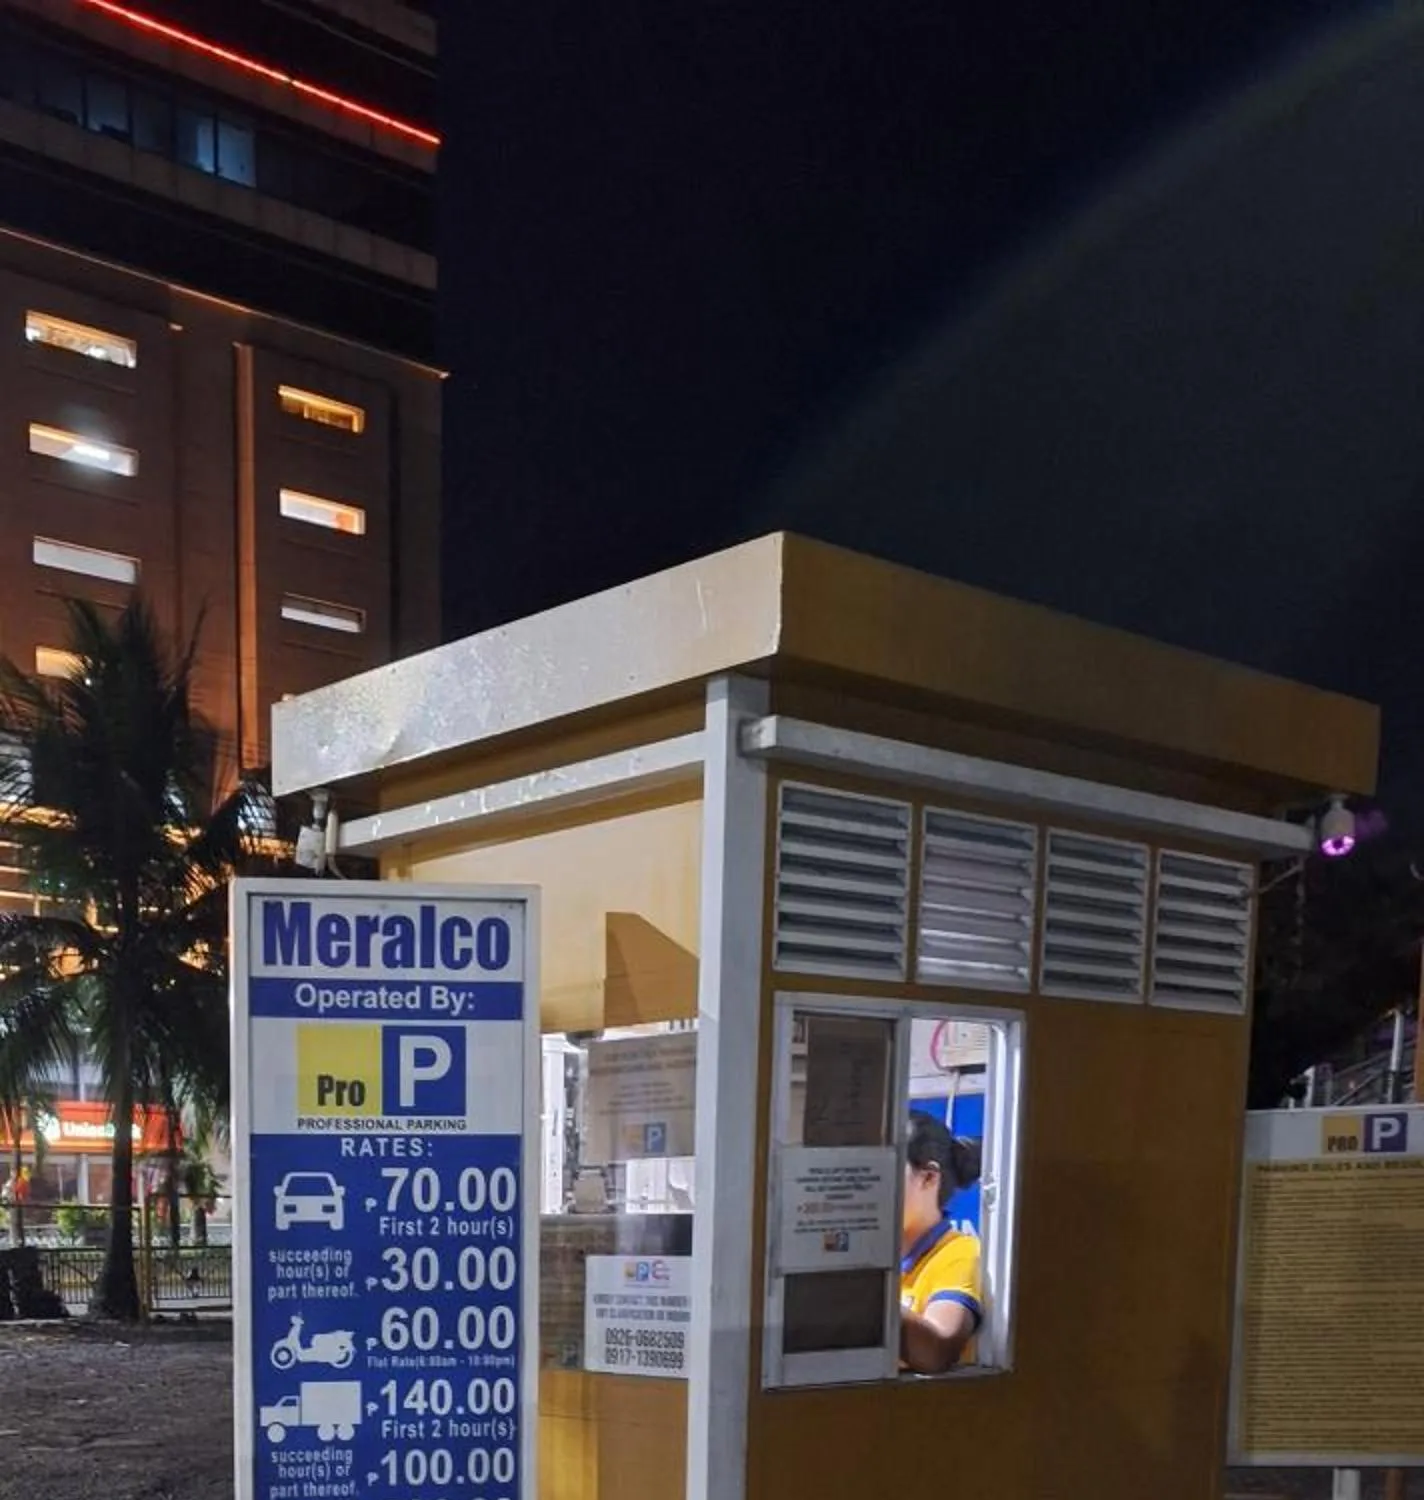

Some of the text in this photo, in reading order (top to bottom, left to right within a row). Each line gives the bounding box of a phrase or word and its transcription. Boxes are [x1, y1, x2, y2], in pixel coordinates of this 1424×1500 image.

[262, 901, 511, 971] Meralco
[295, 983, 475, 1016] Operated By:
[317, 1035, 452, 1107] Pro P
[297, 1117, 467, 1131] PROFESSIONAL PARKING
[1327, 1117, 1400, 1151] PRO P
[340, 1137, 433, 1157] RATES:
[379, 1216, 513, 1238] First 2 hour(s)
[268, 1246, 352, 1267] succeeding
[277, 1264, 329, 1282] hour(s)
[268, 1283, 297, 1302] part
[381, 1418, 515, 1441] First 2 hour(s)
[271, 1445, 353, 1465] succeeding
[278, 1461, 331, 1482] hour(s)
